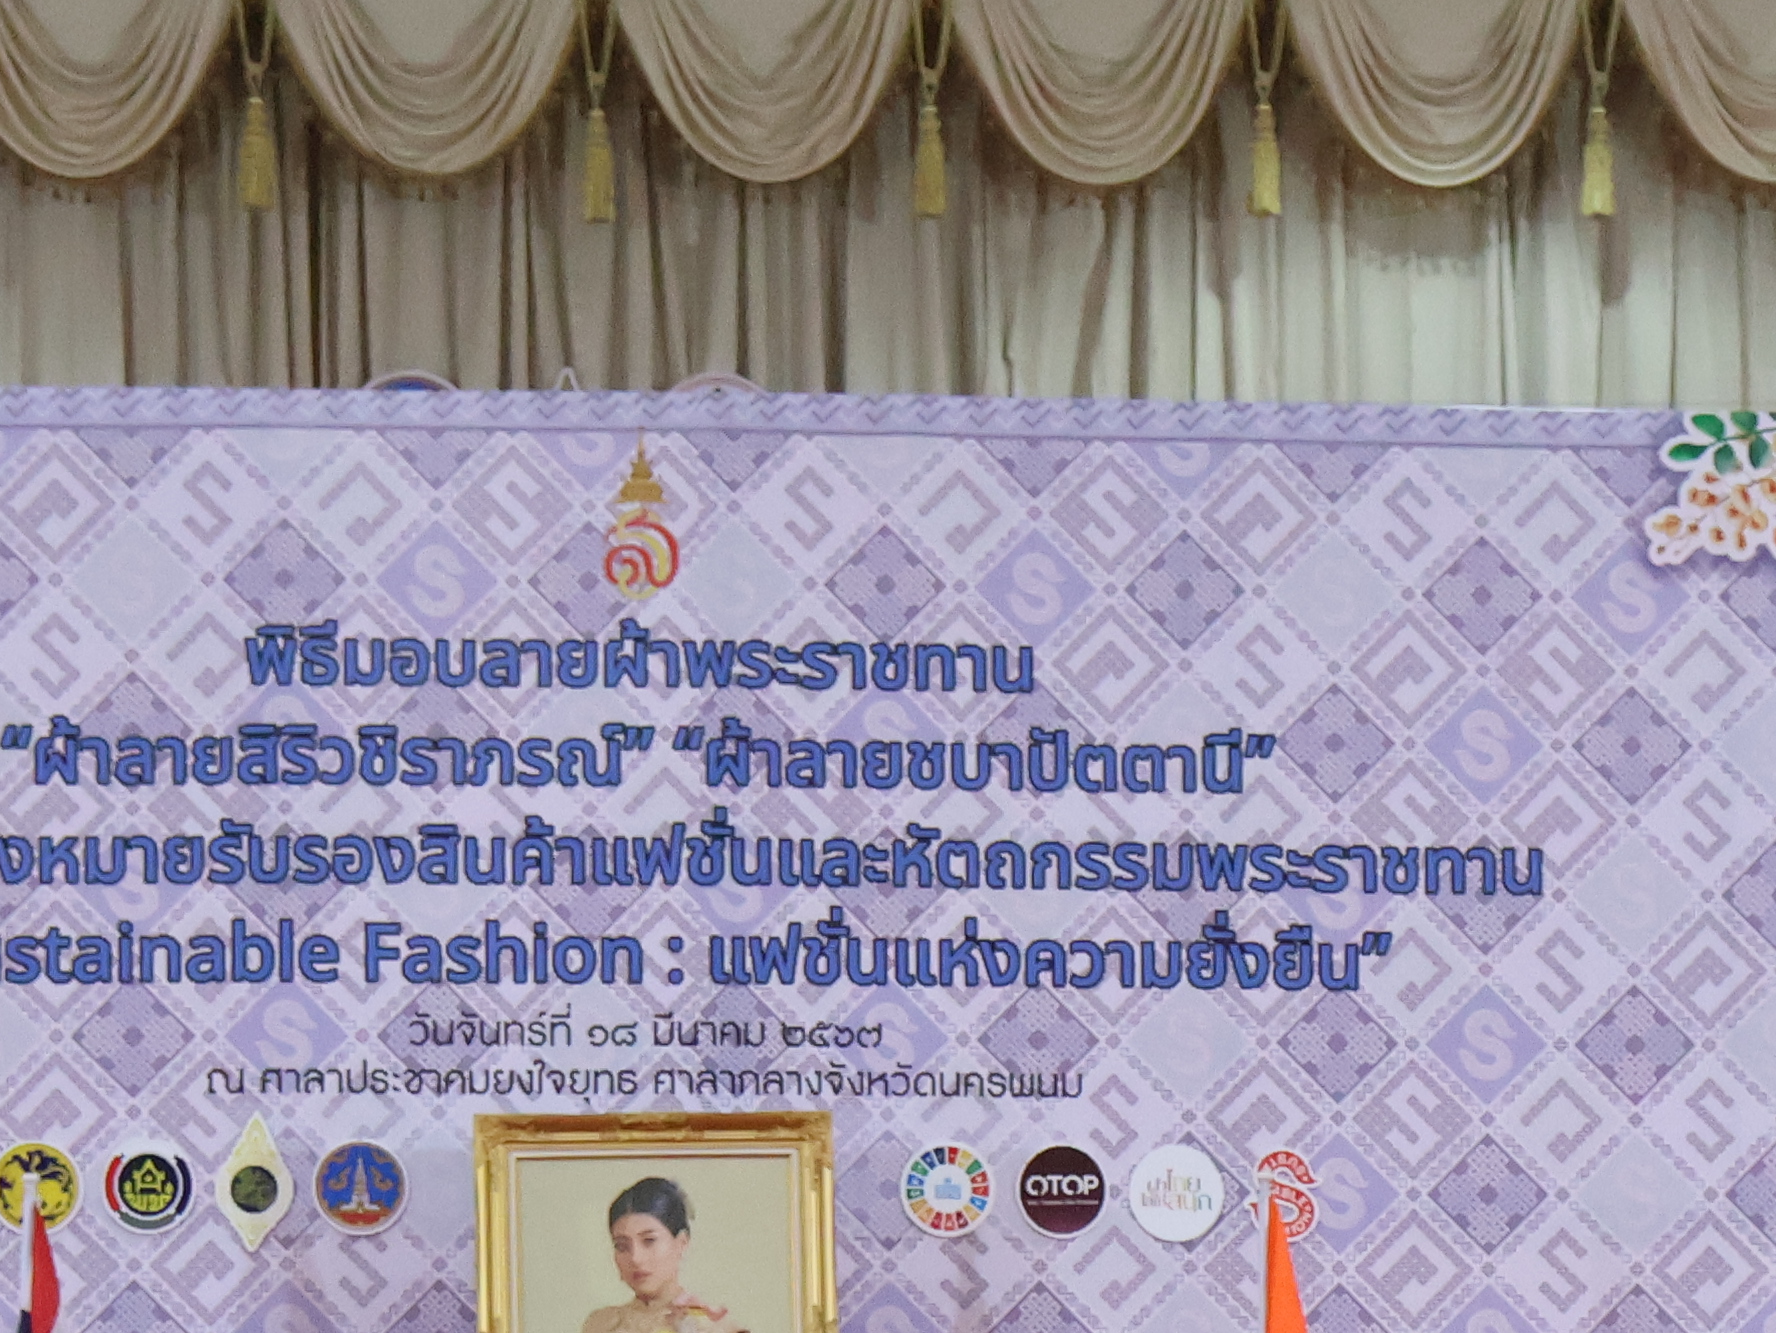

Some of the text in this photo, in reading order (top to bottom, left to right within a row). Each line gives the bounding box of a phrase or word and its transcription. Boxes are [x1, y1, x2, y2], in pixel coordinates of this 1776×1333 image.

[245, 618, 1035, 695] พิธีมอบลายผ้าพระราชทาน
[364, 920, 644, 986] Fashion
[410, 1003, 883, 1048] วันจันทร์ที่ ๑๘ มีนาคม ๒๕๖๗
[208, 1068, 245, 1095] ณ
[653, 1062, 1084, 1098] ศาลากลางจังหวัดนครพนม
[1025, 1174, 1100, 1197] OTOP
